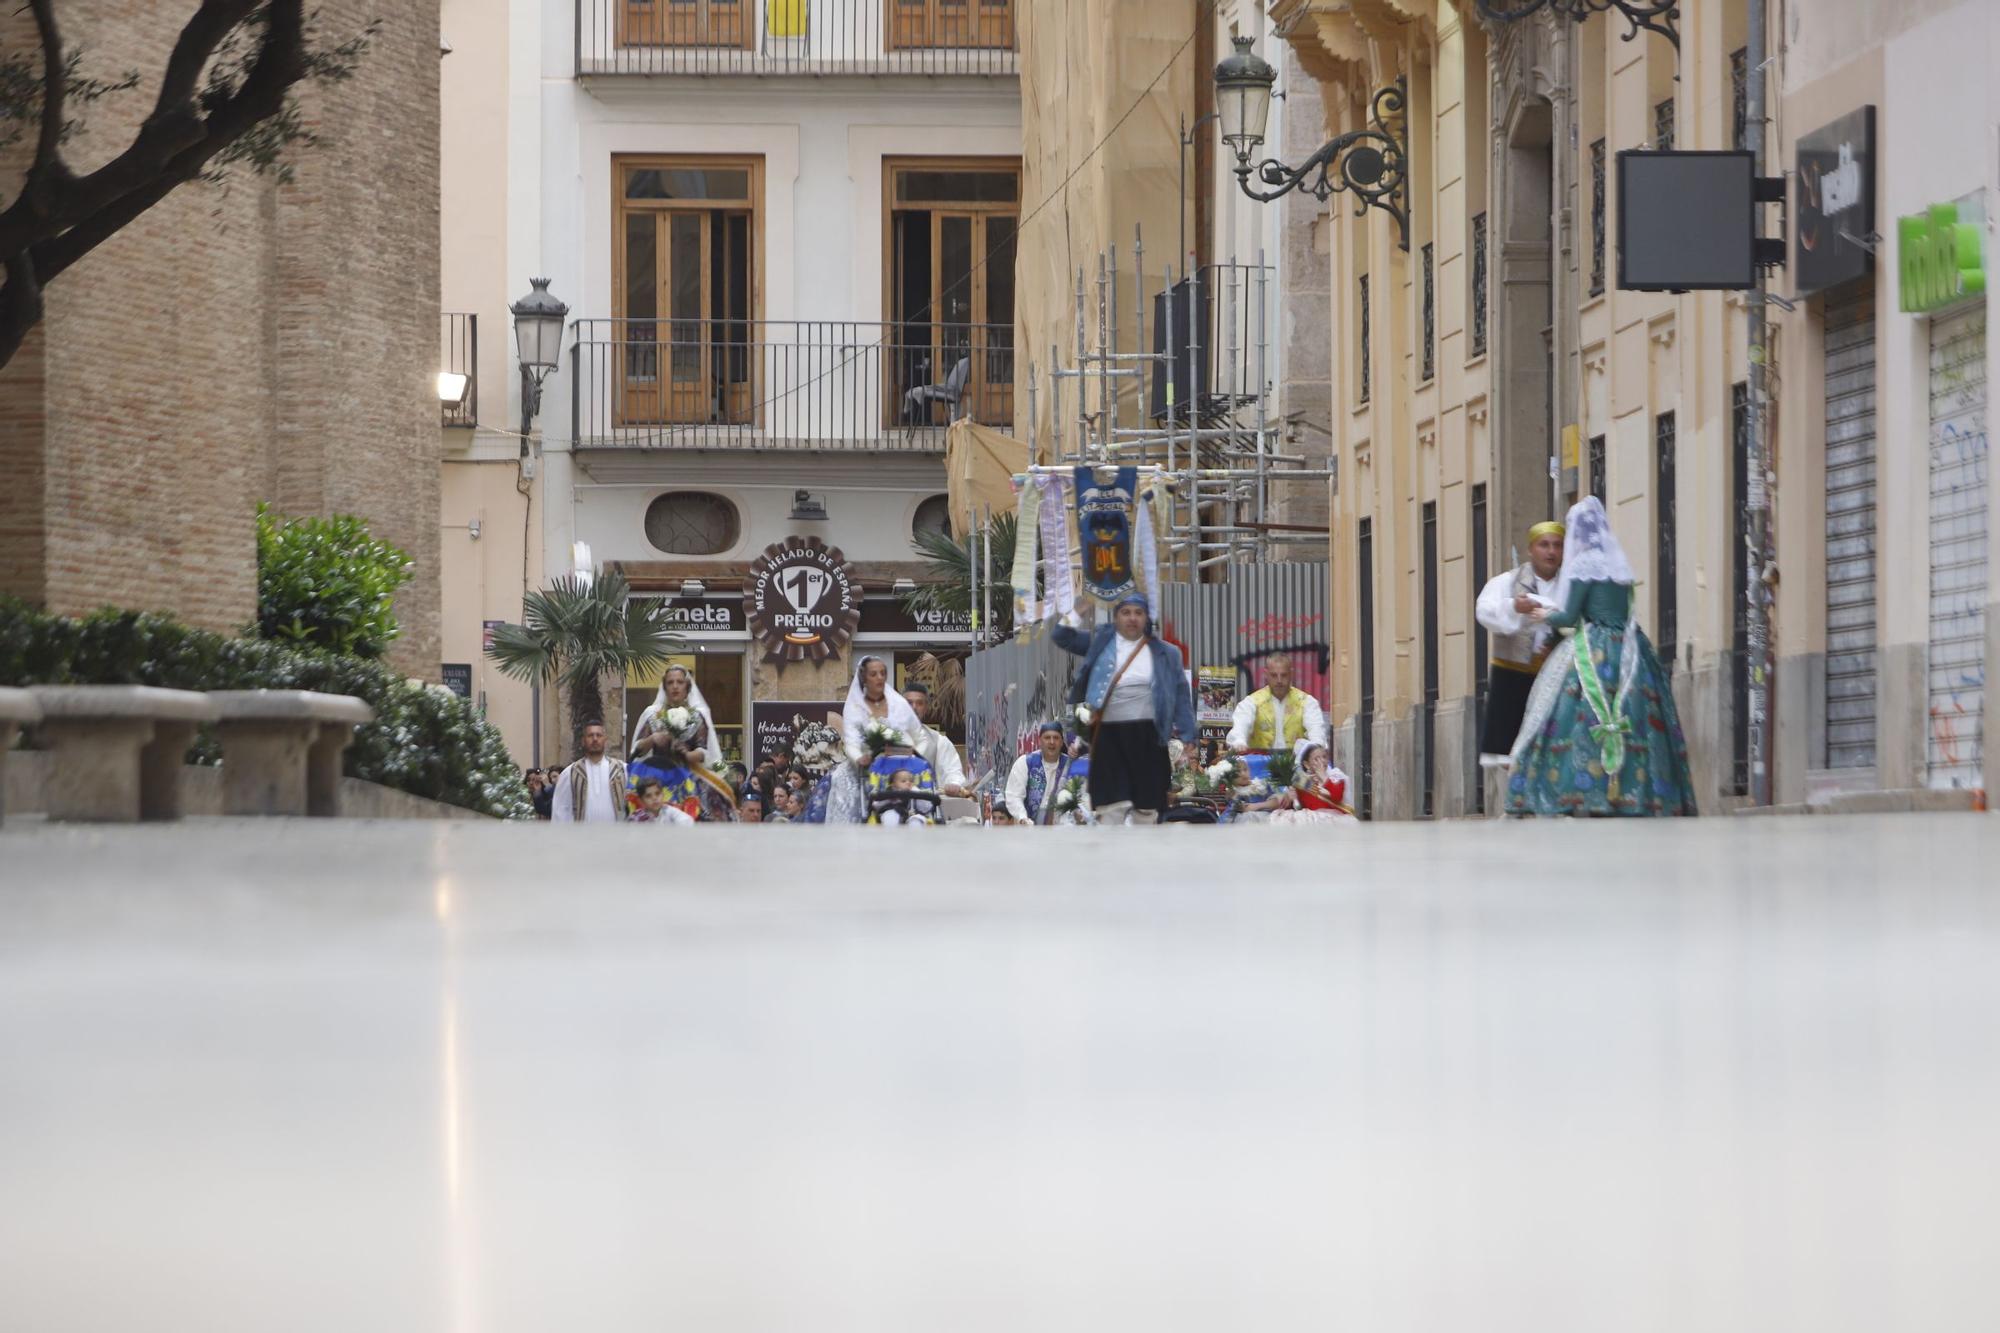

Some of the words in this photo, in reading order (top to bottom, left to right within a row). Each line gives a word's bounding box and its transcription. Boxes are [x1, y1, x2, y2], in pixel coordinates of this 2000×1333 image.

[755, 571, 770, 611] MEJOR
[767, 548, 814, 571] HELADO
[817, 552, 833, 567] DE
[832, 566, 853, 611] ESPAÑA
[786, 569, 823, 608] 1er
[700, 623, 731, 631] ITALIANO
[774, 614, 833, 627] PREMIO
[916, 624, 935, 632] FOOD
[942, 624, 967, 632] GELATO
[757, 720, 792, 734] Helados
[762, 735, 777, 744] 100
